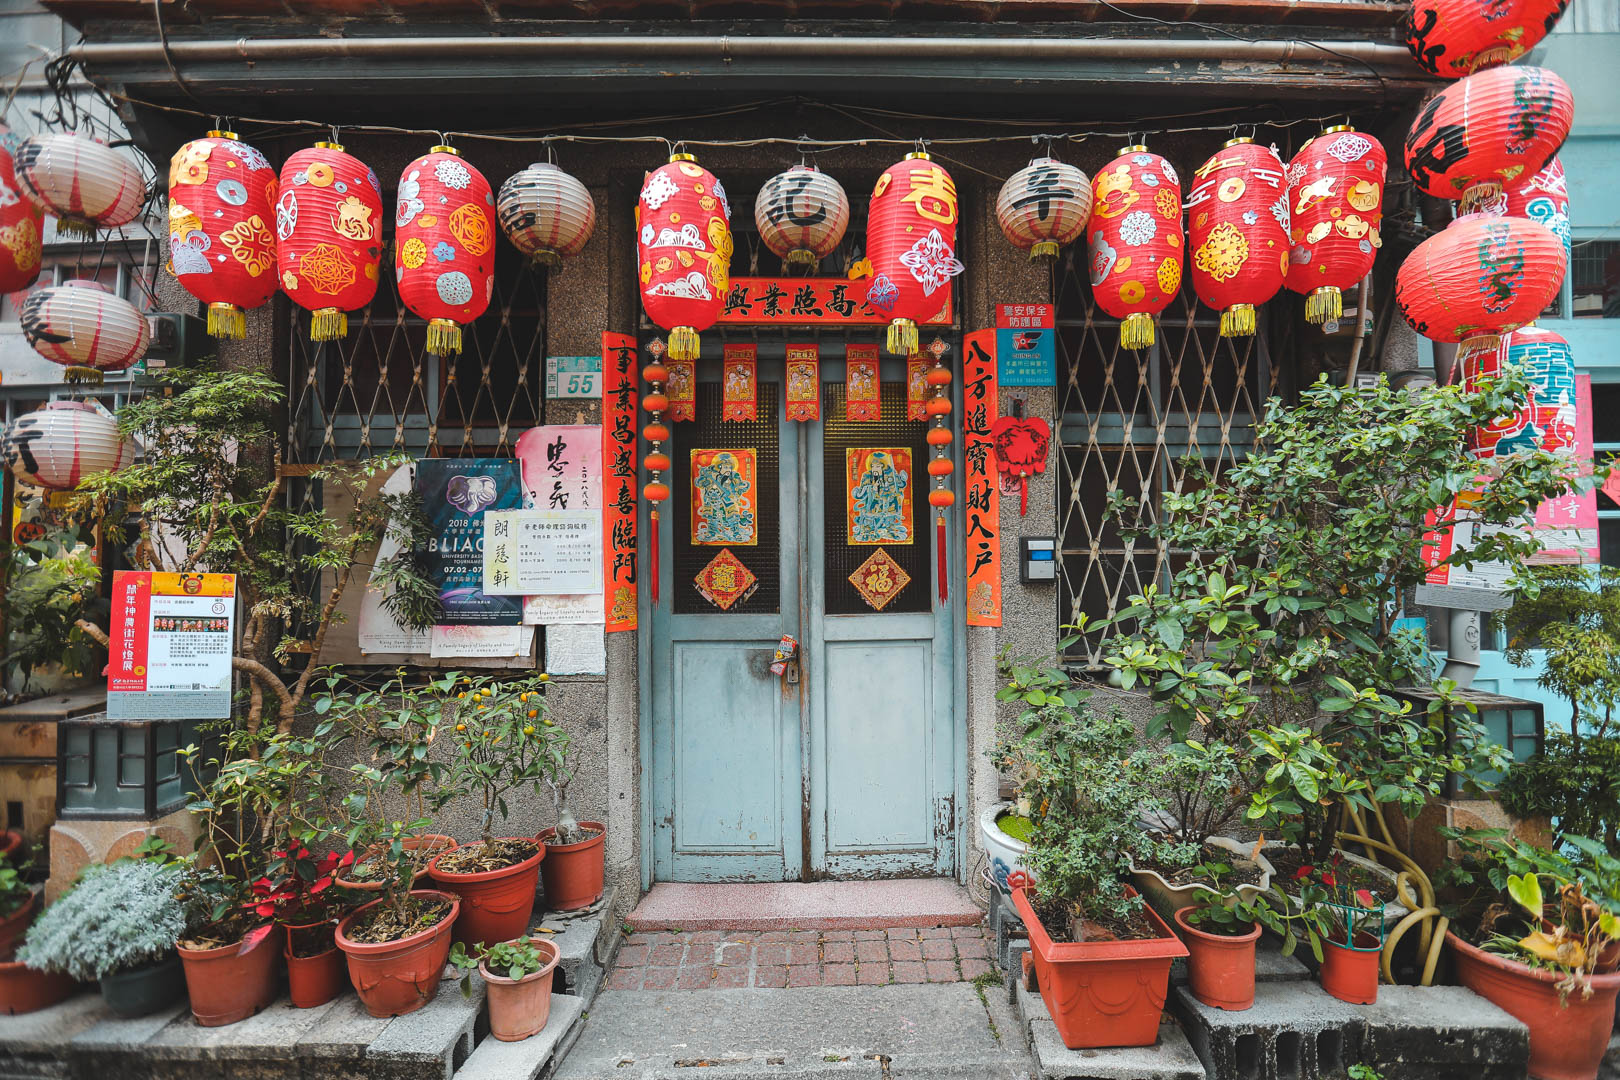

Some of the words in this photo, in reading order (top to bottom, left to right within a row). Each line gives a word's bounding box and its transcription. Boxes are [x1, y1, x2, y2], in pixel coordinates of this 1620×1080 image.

[766, 174, 827, 227] 記
[901, 167, 958, 225] 春
[1012, 166, 1075, 221] 辛
[1004, 305, 1047, 316] 警安保全
[1009, 316, 1042, 327] 防護區
[548, 360, 557, 395] 中西區
[568, 374, 594, 394] 55
[607, 339, 637, 584] 事業昌盛喜臨門
[449, 519, 468, 528] 2018
[493, 520, 510, 588] 朗慈軒
[865, 564, 894, 593] 福
[214, 604, 223, 612] 53
[122, 584, 137, 671] 鼠年神農街花燈展
